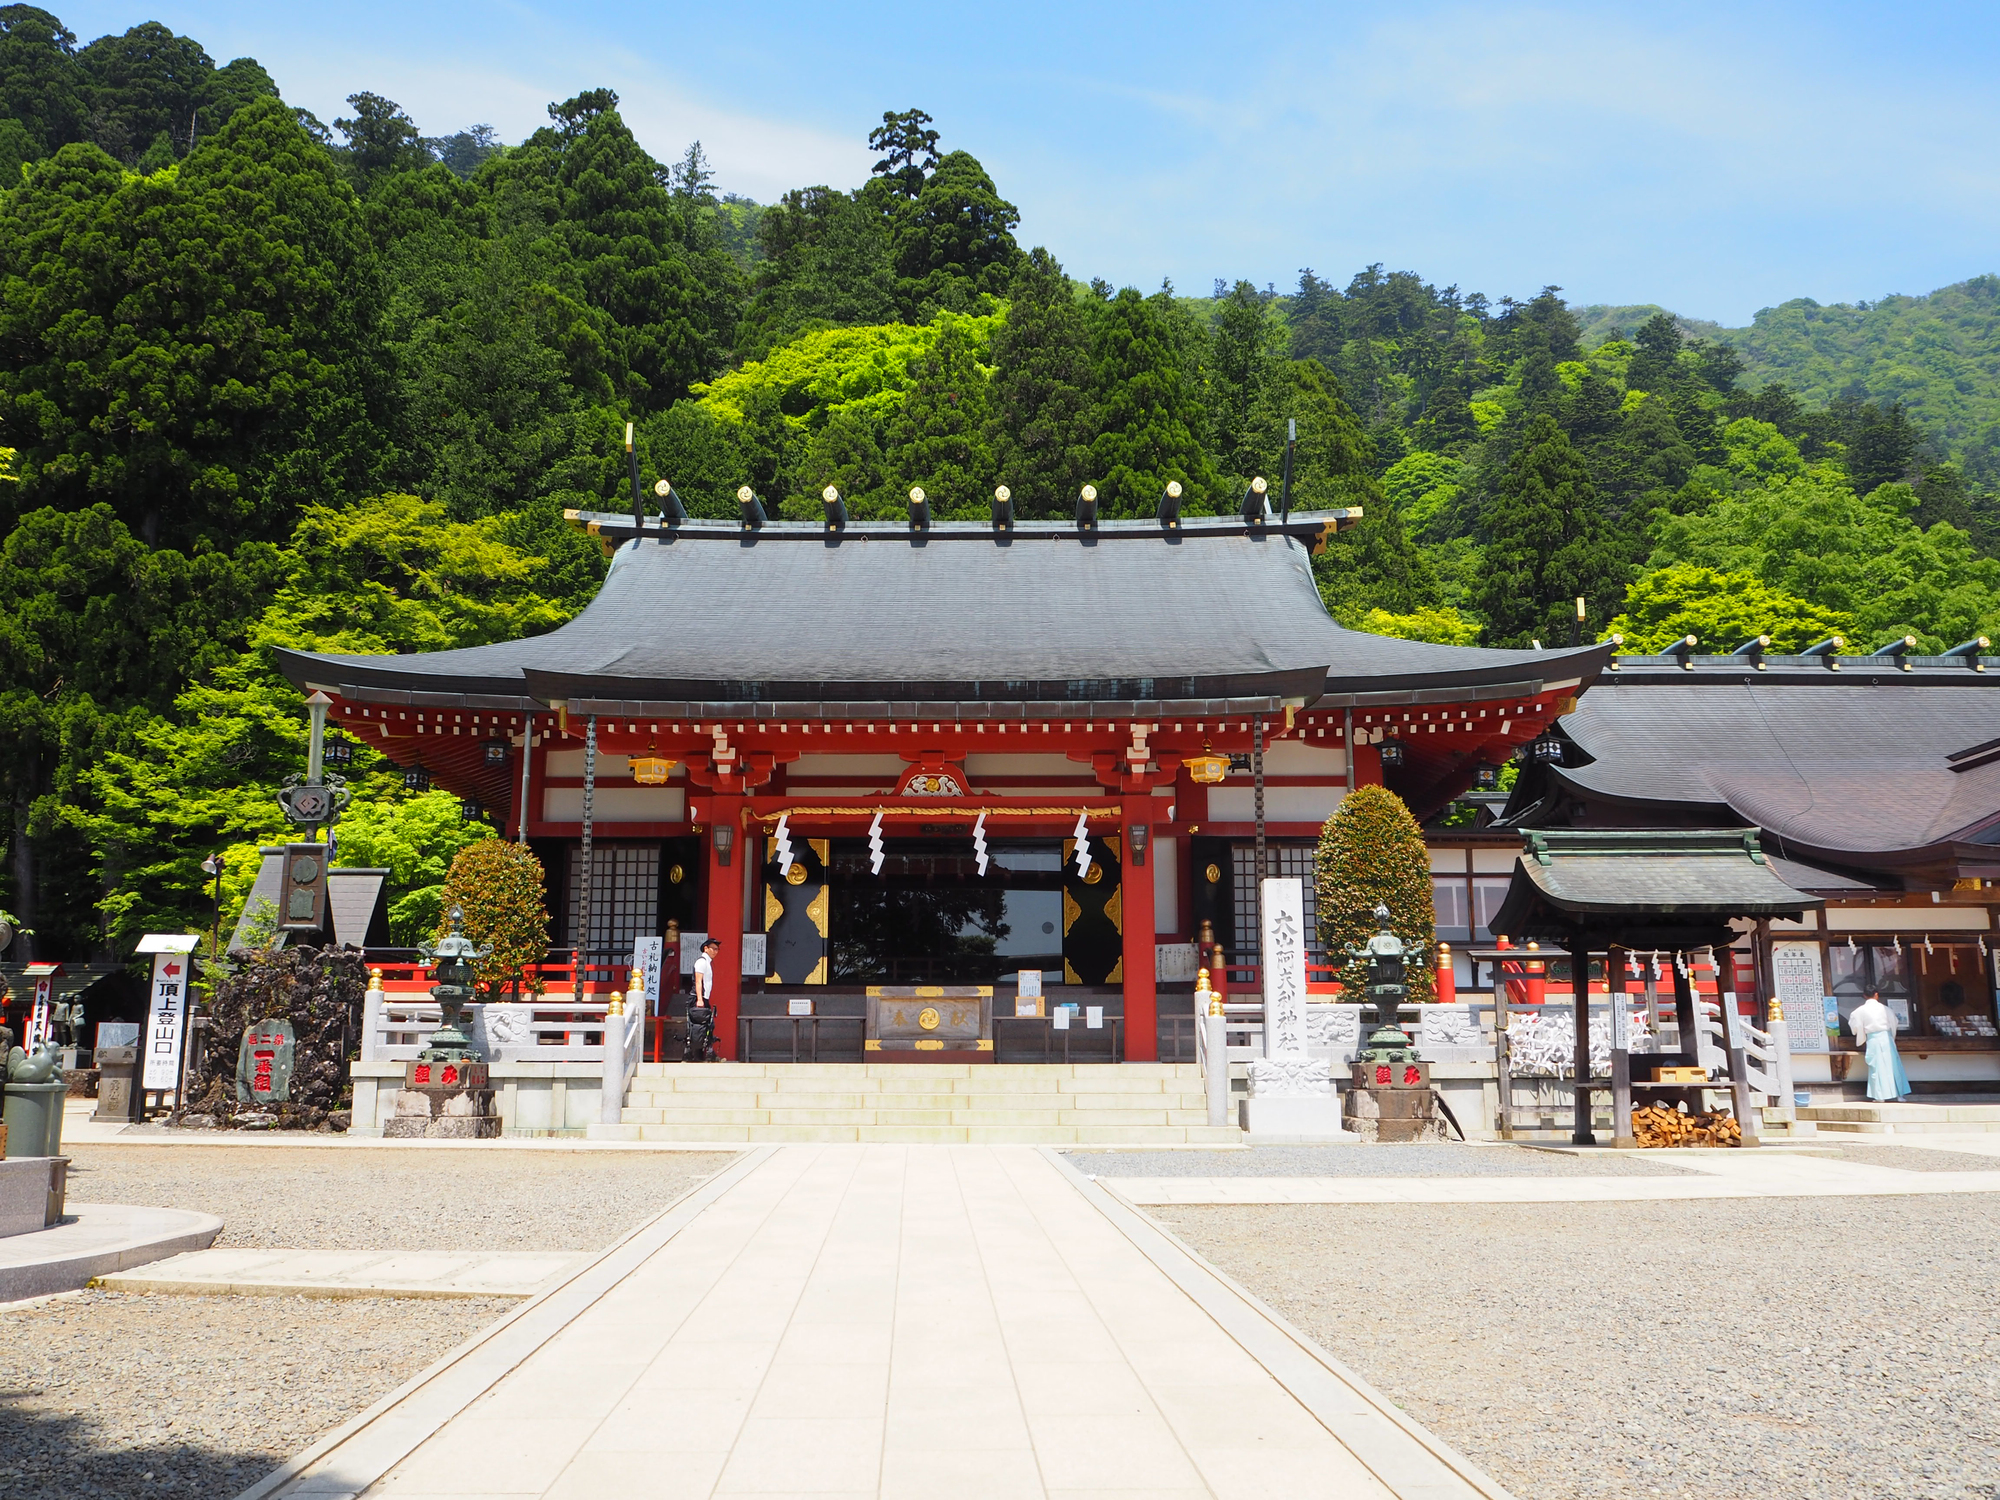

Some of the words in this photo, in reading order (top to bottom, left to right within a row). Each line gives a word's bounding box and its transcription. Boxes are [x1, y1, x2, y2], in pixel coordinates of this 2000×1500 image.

[646, 941, 659, 996] 古札納札処
[1271, 909, 1300, 1051] 大山阿夫利神社
[154, 983, 179, 1054] 頂上登山口
[892, 1009, 909, 1027] 奉
[950, 1009, 972, 1027] 献
[149, 1059, 175, 1067] 所要時間
[254, 1050, 275, 1093] 一番組
